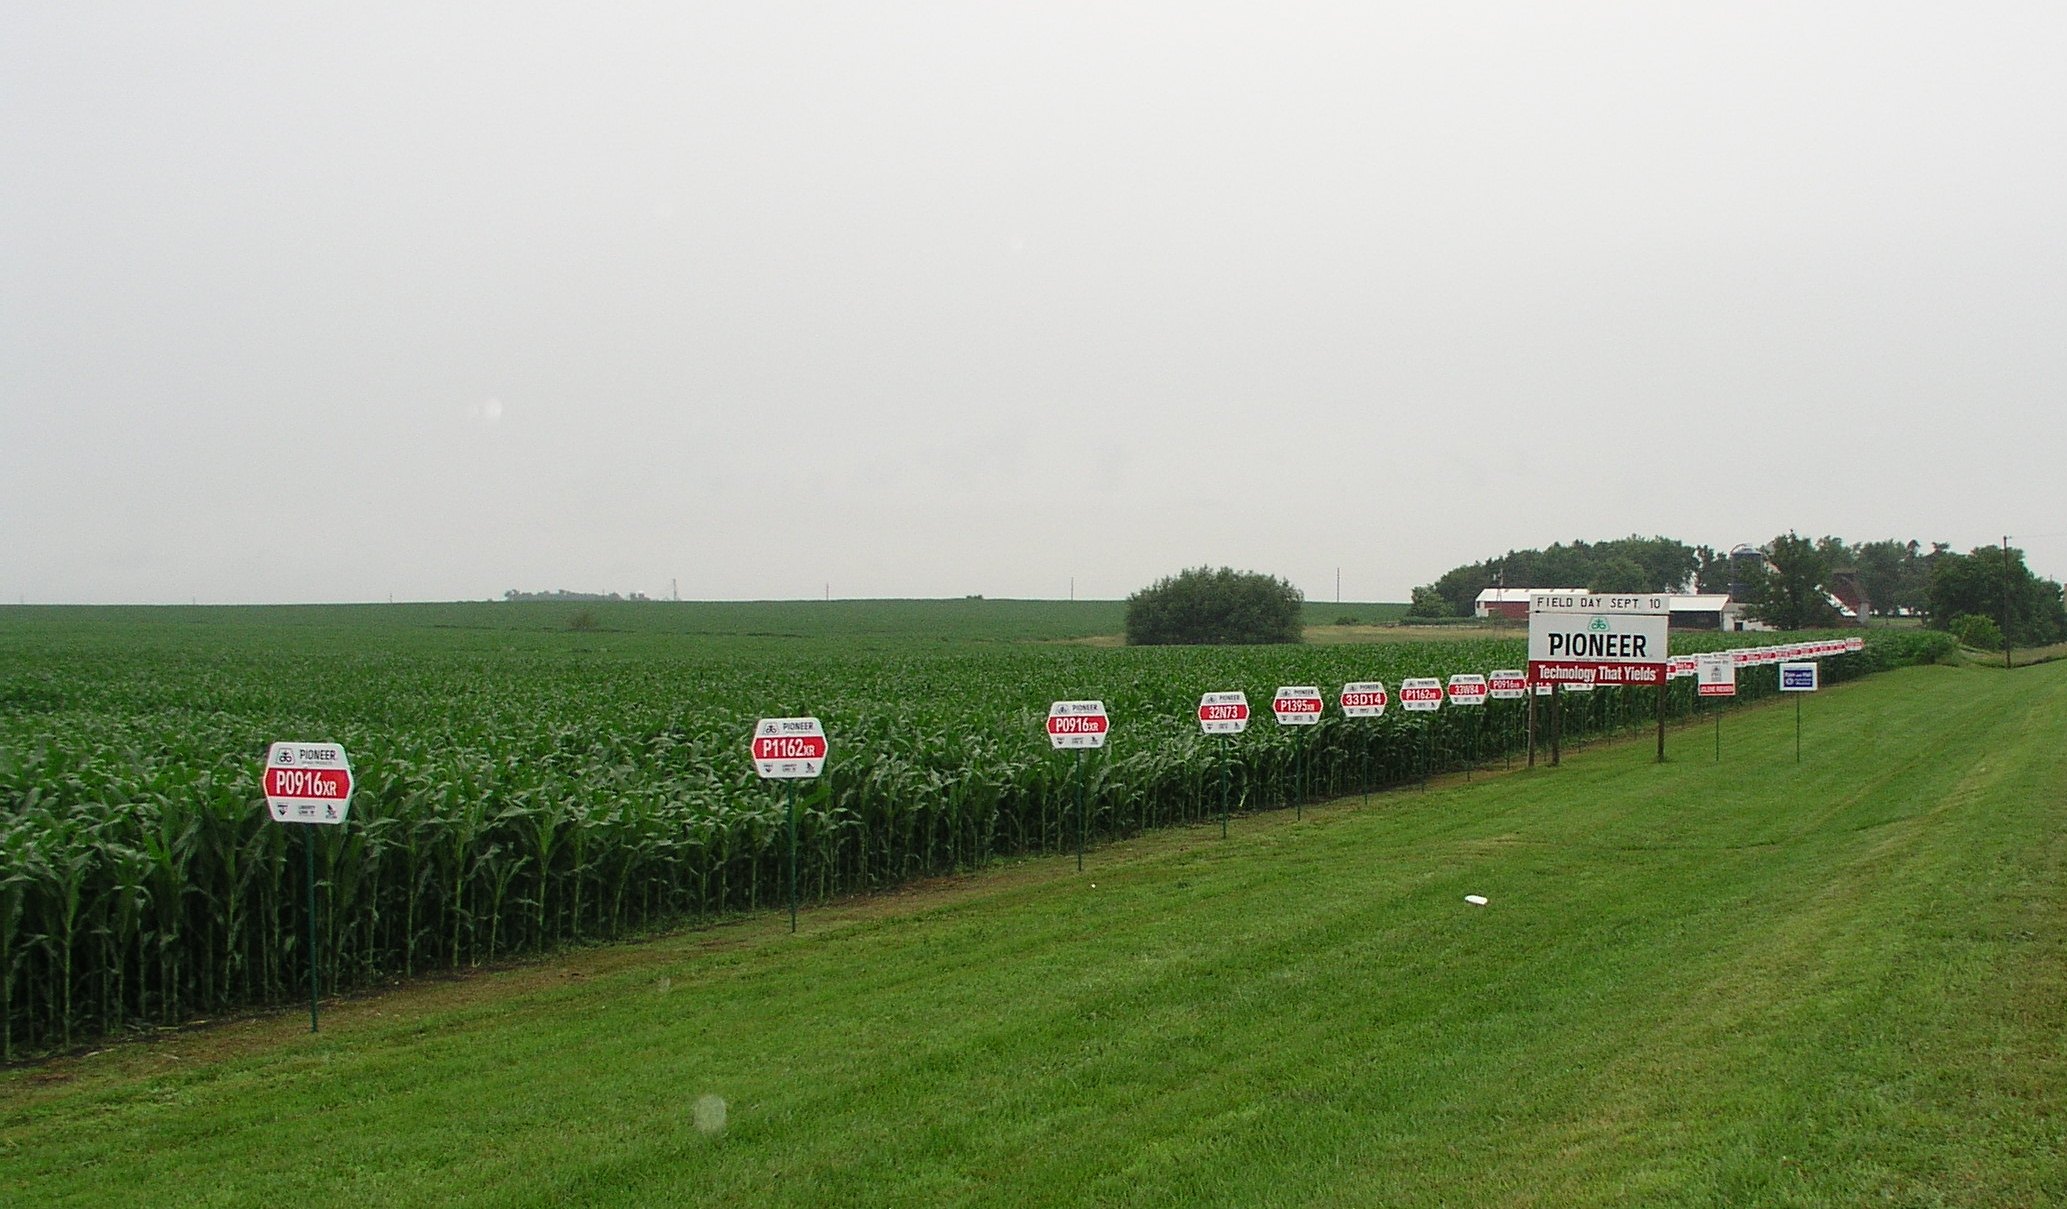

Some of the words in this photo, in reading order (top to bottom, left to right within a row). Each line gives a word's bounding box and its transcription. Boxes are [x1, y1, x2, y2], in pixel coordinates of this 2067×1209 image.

[1537, 597, 1573, 608] FIELD
[1580, 598, 1602, 608] DAY
[1650, 598, 1661, 609] 10
[1548, 633, 1647, 658] PIONEER
[1538, 664, 1597, 682] Technology
[1598, 665, 1622, 681] That
[1624, 666, 1657, 682] Yields
[1346, 694, 1381, 705] 33D14
[1208, 706, 1238, 718] 32N73
[783, 722, 814, 730] PIONEER
[1056, 718, 1098, 732] P0916XR
[762, 738, 815, 757] P1162XR
[300, 749, 336, 760] PIONEER
[276, 770, 337, 796] P0916XR
